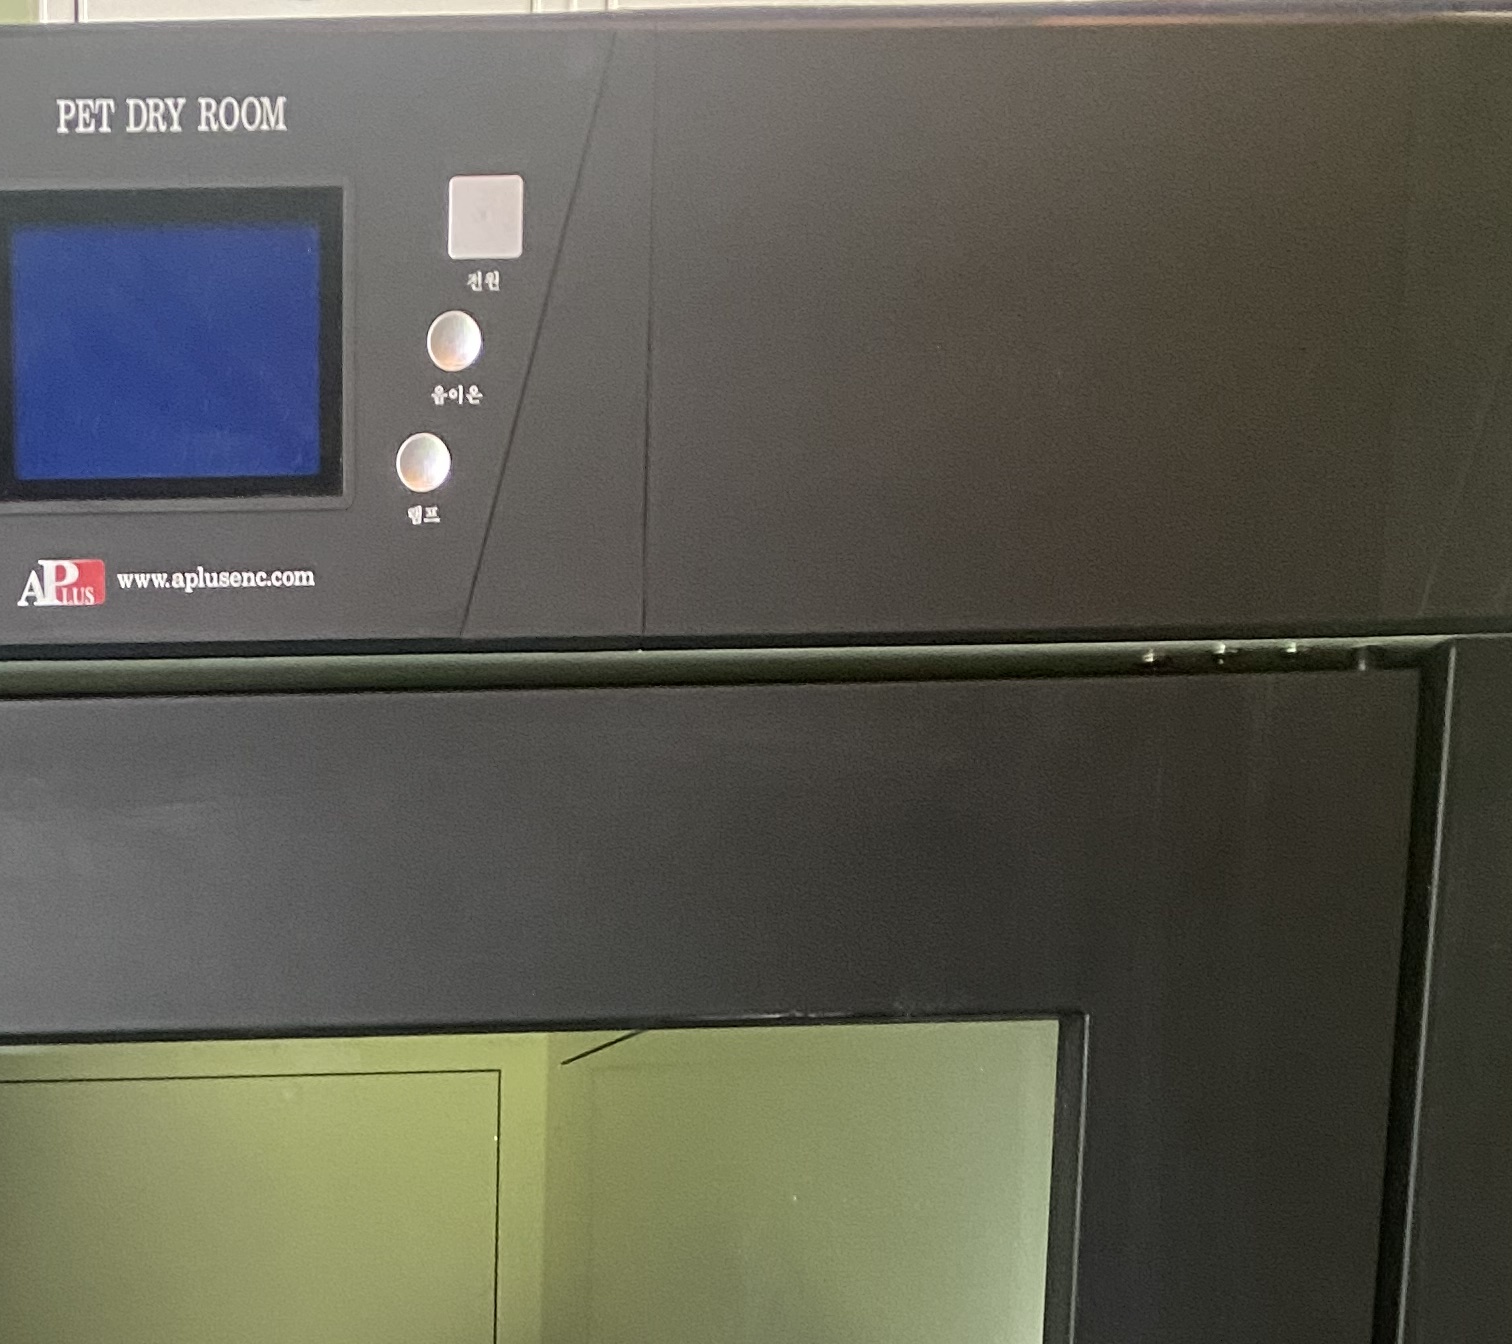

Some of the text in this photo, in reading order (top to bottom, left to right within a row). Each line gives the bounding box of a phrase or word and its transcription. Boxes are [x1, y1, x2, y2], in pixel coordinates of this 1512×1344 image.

[56, 96, 288, 134] PET DRY ROOM
[466, 270, 500, 292] 전원
[116, 565, 316, 594] www.aplusenc.com
